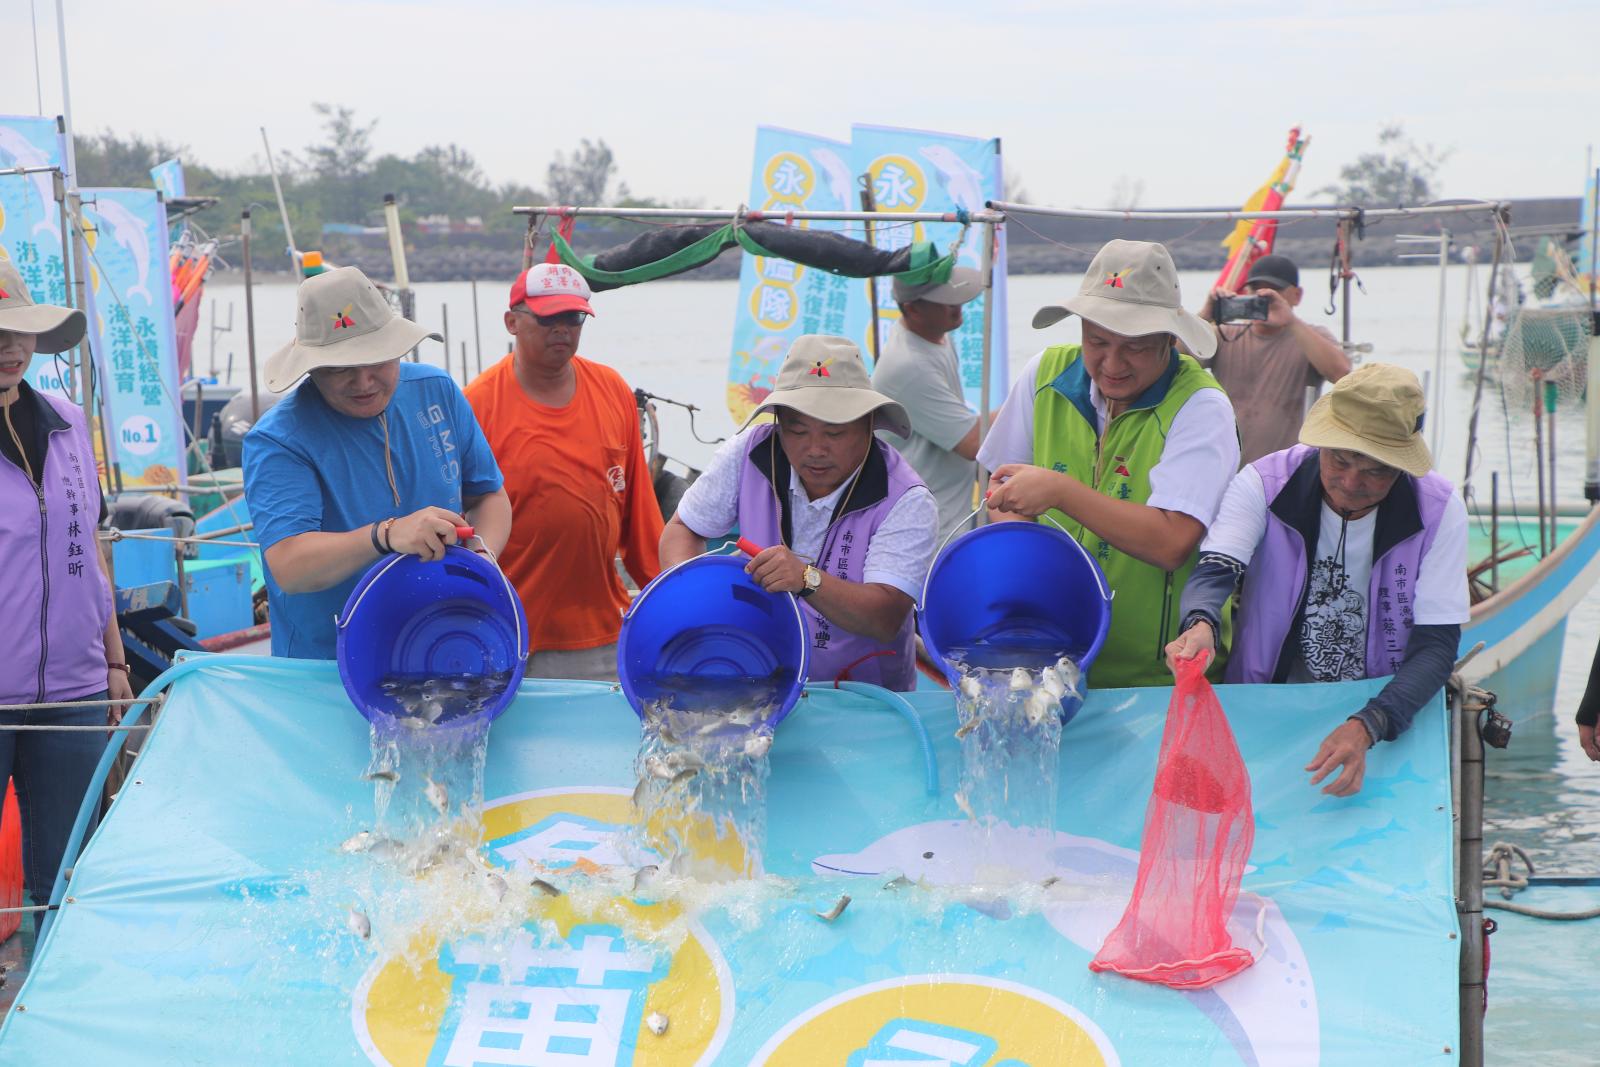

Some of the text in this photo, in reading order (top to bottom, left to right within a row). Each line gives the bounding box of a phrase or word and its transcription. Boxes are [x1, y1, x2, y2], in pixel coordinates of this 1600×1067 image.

[108, 303, 135, 393] 海洋復育
[135, 316, 162, 406] 永續經營
[122, 423, 158, 444] No.1
